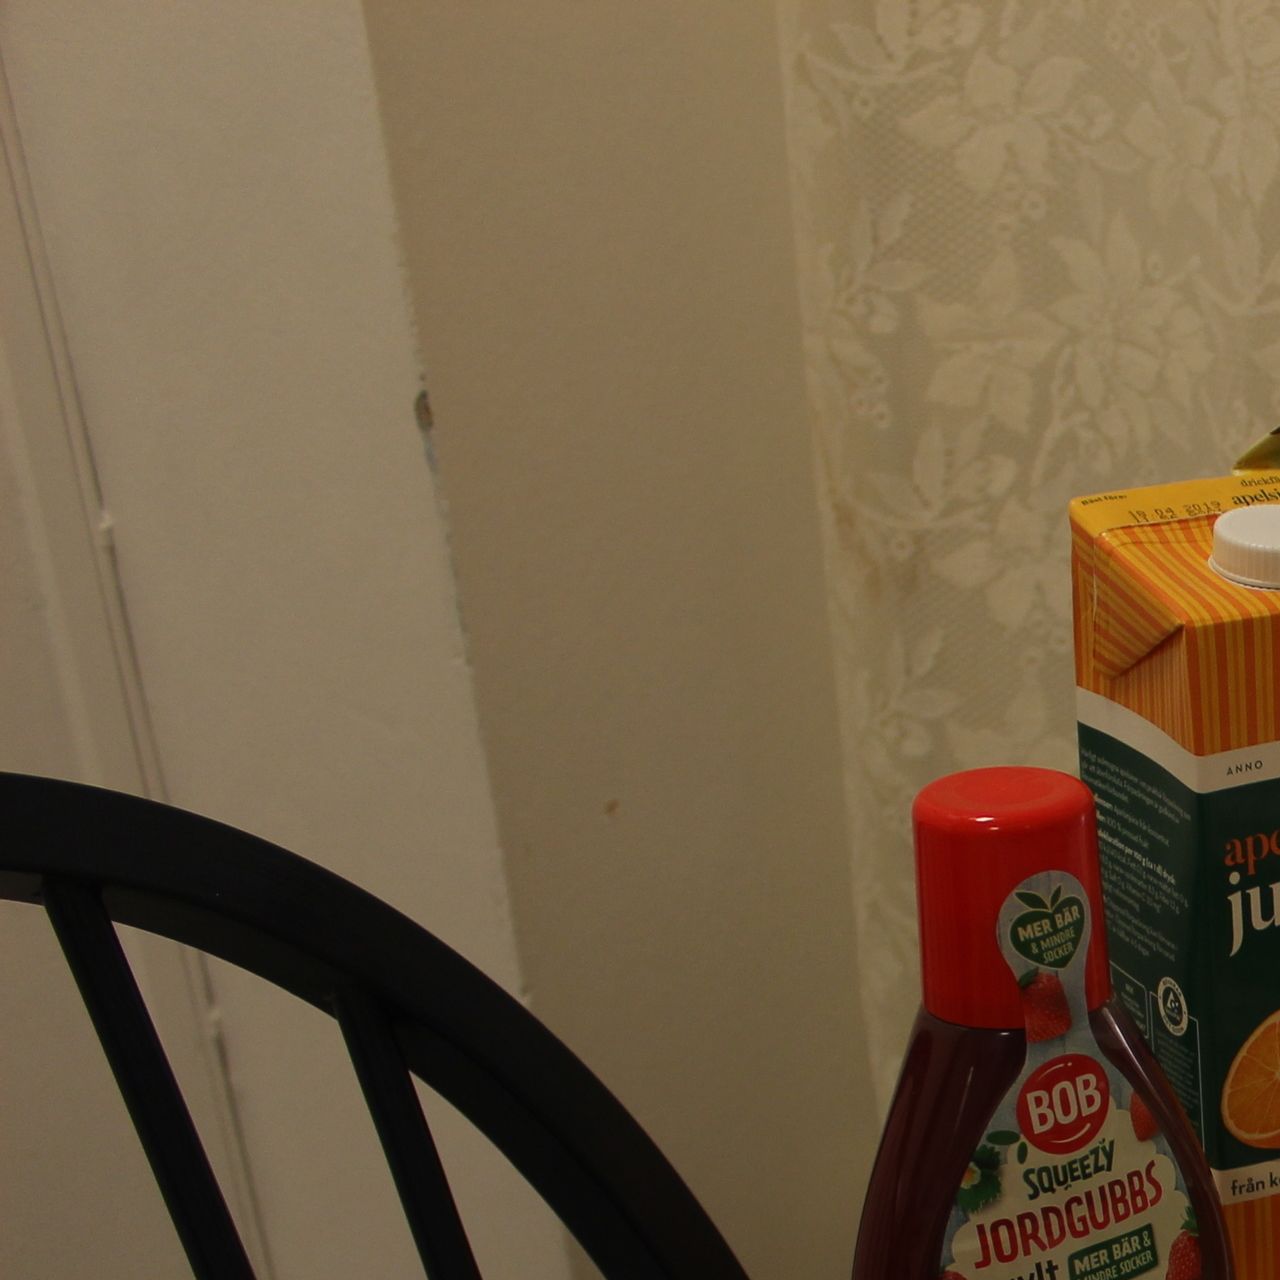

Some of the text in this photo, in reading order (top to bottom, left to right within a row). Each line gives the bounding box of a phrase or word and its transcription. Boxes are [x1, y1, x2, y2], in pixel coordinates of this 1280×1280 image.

[1226, 760, 1264, 776] ANNO
[1017, 904, 1081, 943] MER BÄR
[1031, 926, 1076, 954] & MINDRE
[1042, 943, 1074, 964] SOCKER
[1026, 1072, 1102, 1136] BOB
[1022, 1139, 1115, 1201] SQUEEZY
[1230, 1177, 1266, 1197] från
[974, 1160, 1163, 1270] JORDGUBBS
[1074, 1230, 1152, 1274] MER BÄR &
[1118, 1251, 1154, 1279] SOCKER
